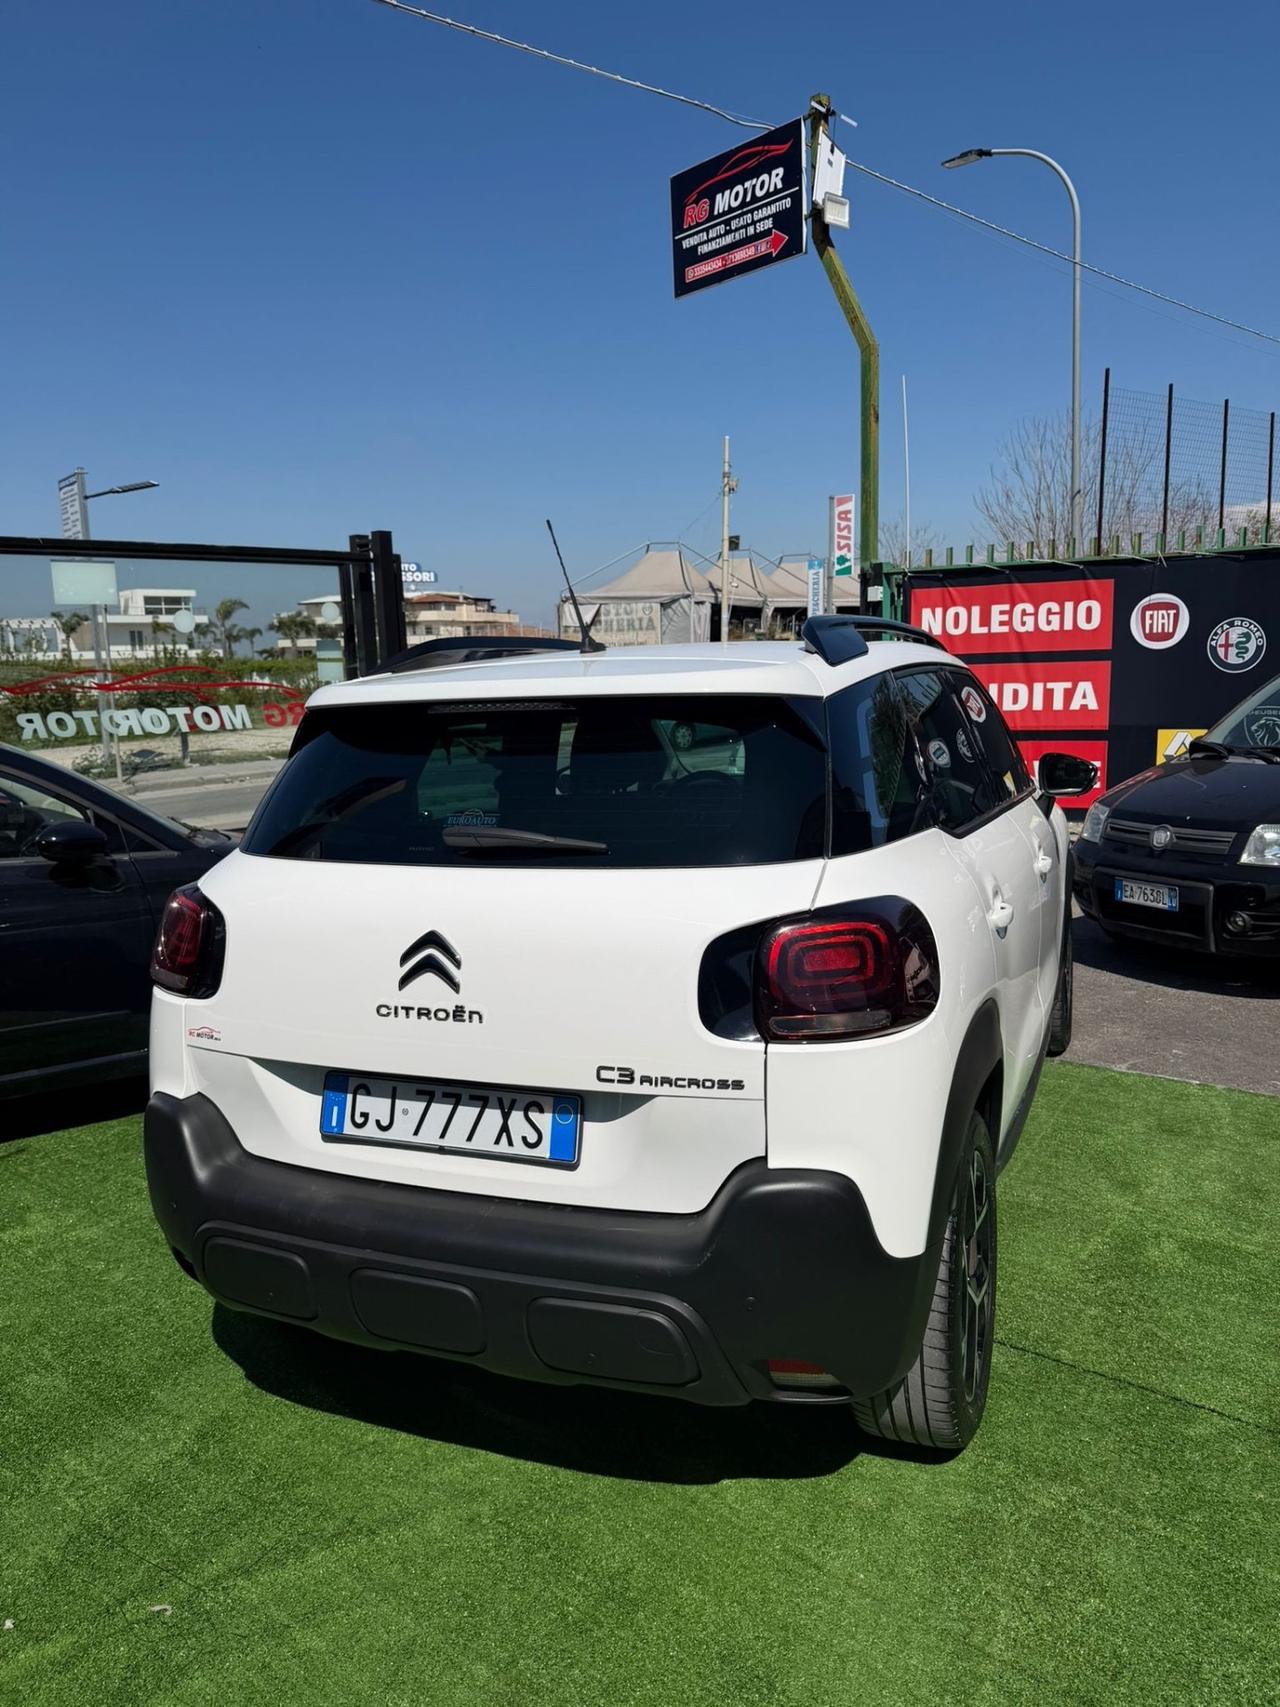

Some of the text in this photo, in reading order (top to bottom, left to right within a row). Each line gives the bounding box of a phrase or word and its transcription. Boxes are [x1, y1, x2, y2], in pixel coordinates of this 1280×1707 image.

[684, 167, 784, 229] RG MOTOR
[682, 231, 707, 249] VENDITA
[708, 224, 725, 240] AUTO
[731, 213, 752, 230] USATO
[753, 197, 792, 221] GARANTITO
[697, 217, 773, 255] FINANZIAMENTI IN SEDE
[837, 509, 852, 553] SISA
[921, 600, 1101, 635] NOLEGGIO
[1145, 609, 1177, 634] FIAT
[1210, 619, 1263, 647] ALFA ROMEO
[447, 816, 497, 825] EUROAUTO
[596, 1065, 745, 1091] C3 AIRCROSS
